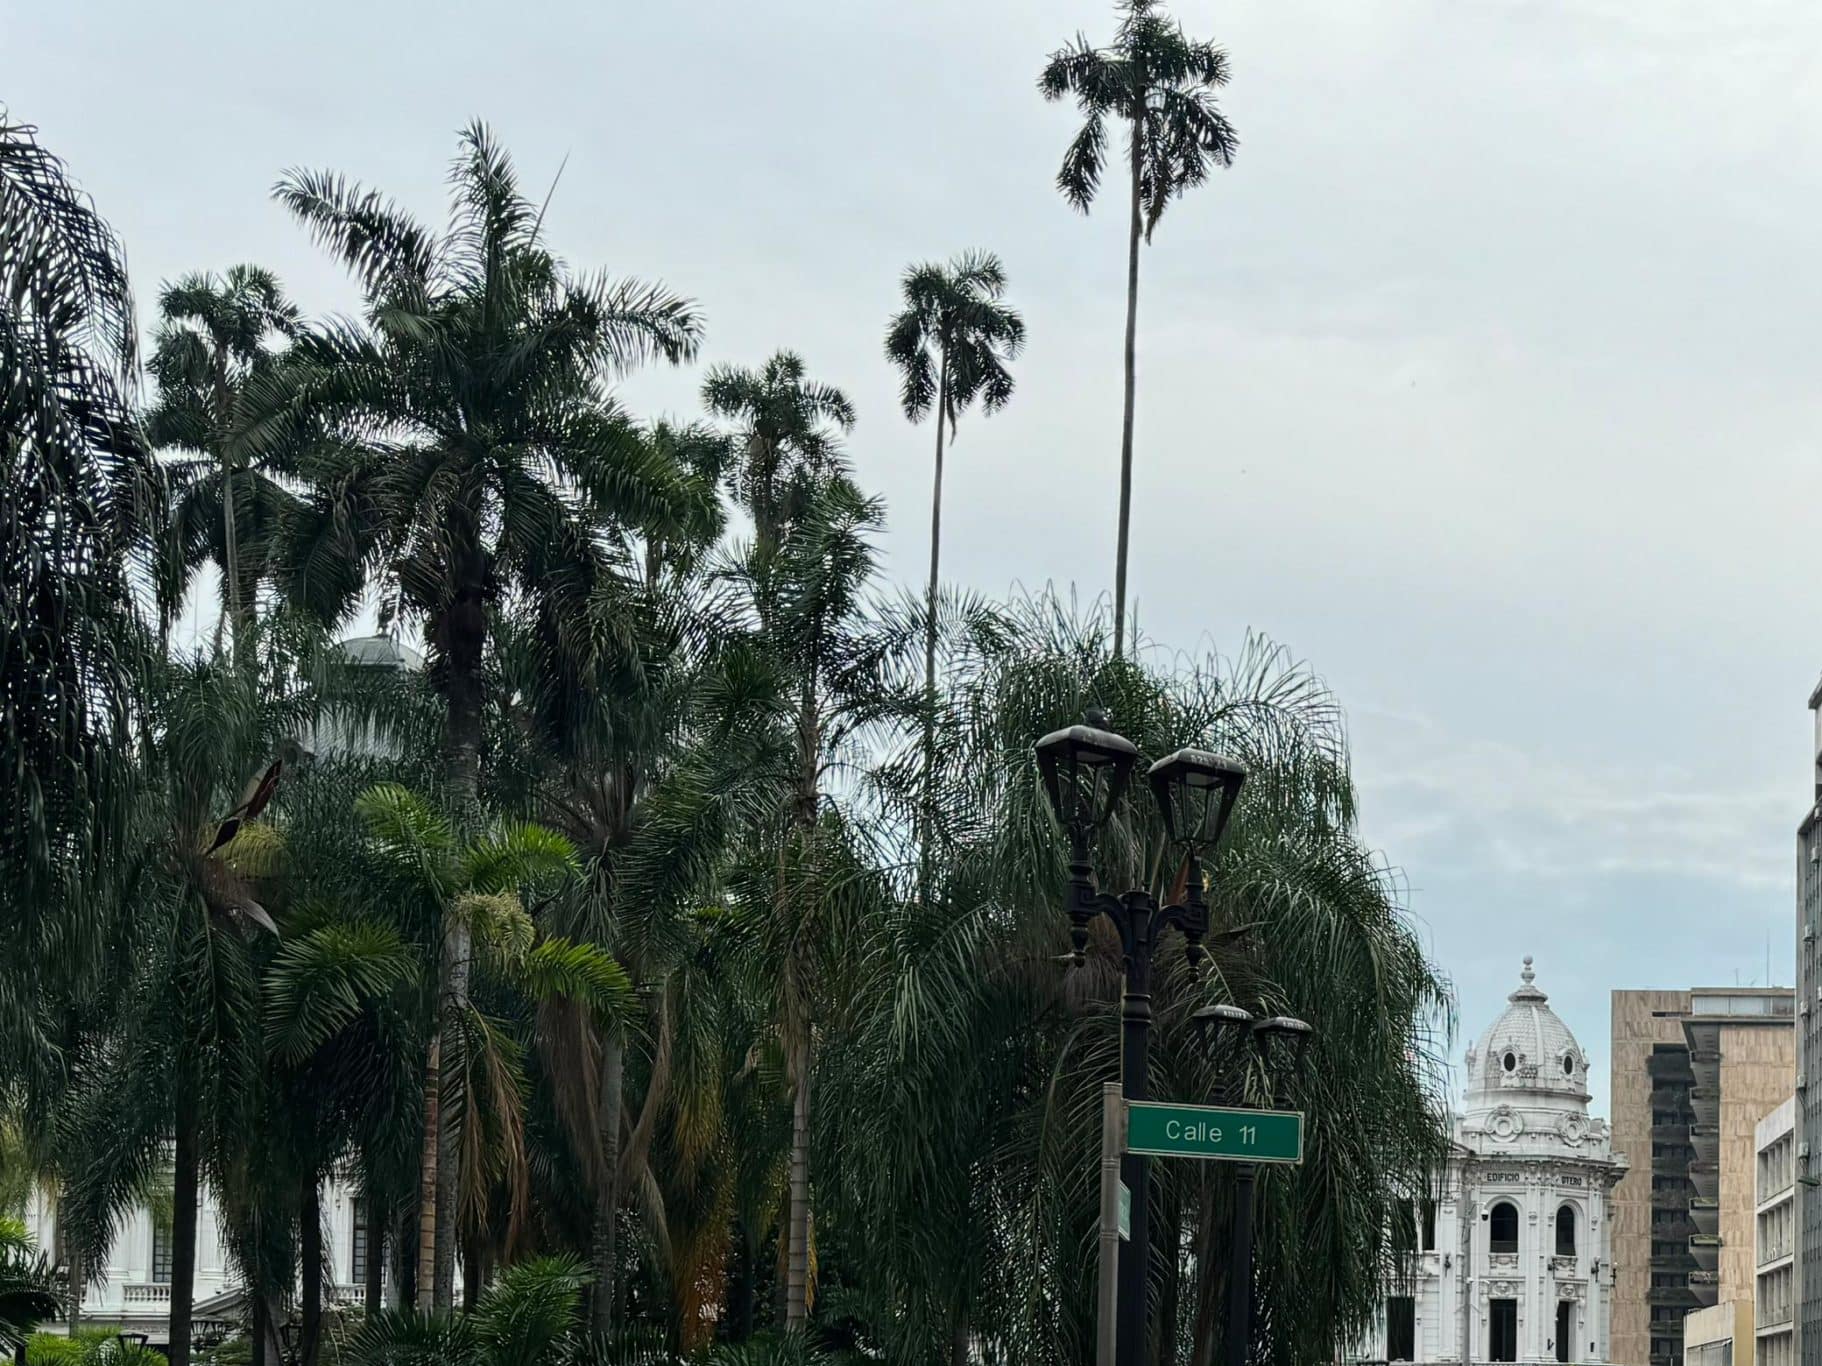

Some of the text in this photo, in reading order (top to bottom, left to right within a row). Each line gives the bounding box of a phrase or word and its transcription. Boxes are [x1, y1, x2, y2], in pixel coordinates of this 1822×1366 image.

[1165, 1120, 1256, 1145] Calle 11
[1486, 1173, 1520, 1182] EDIFICIO
